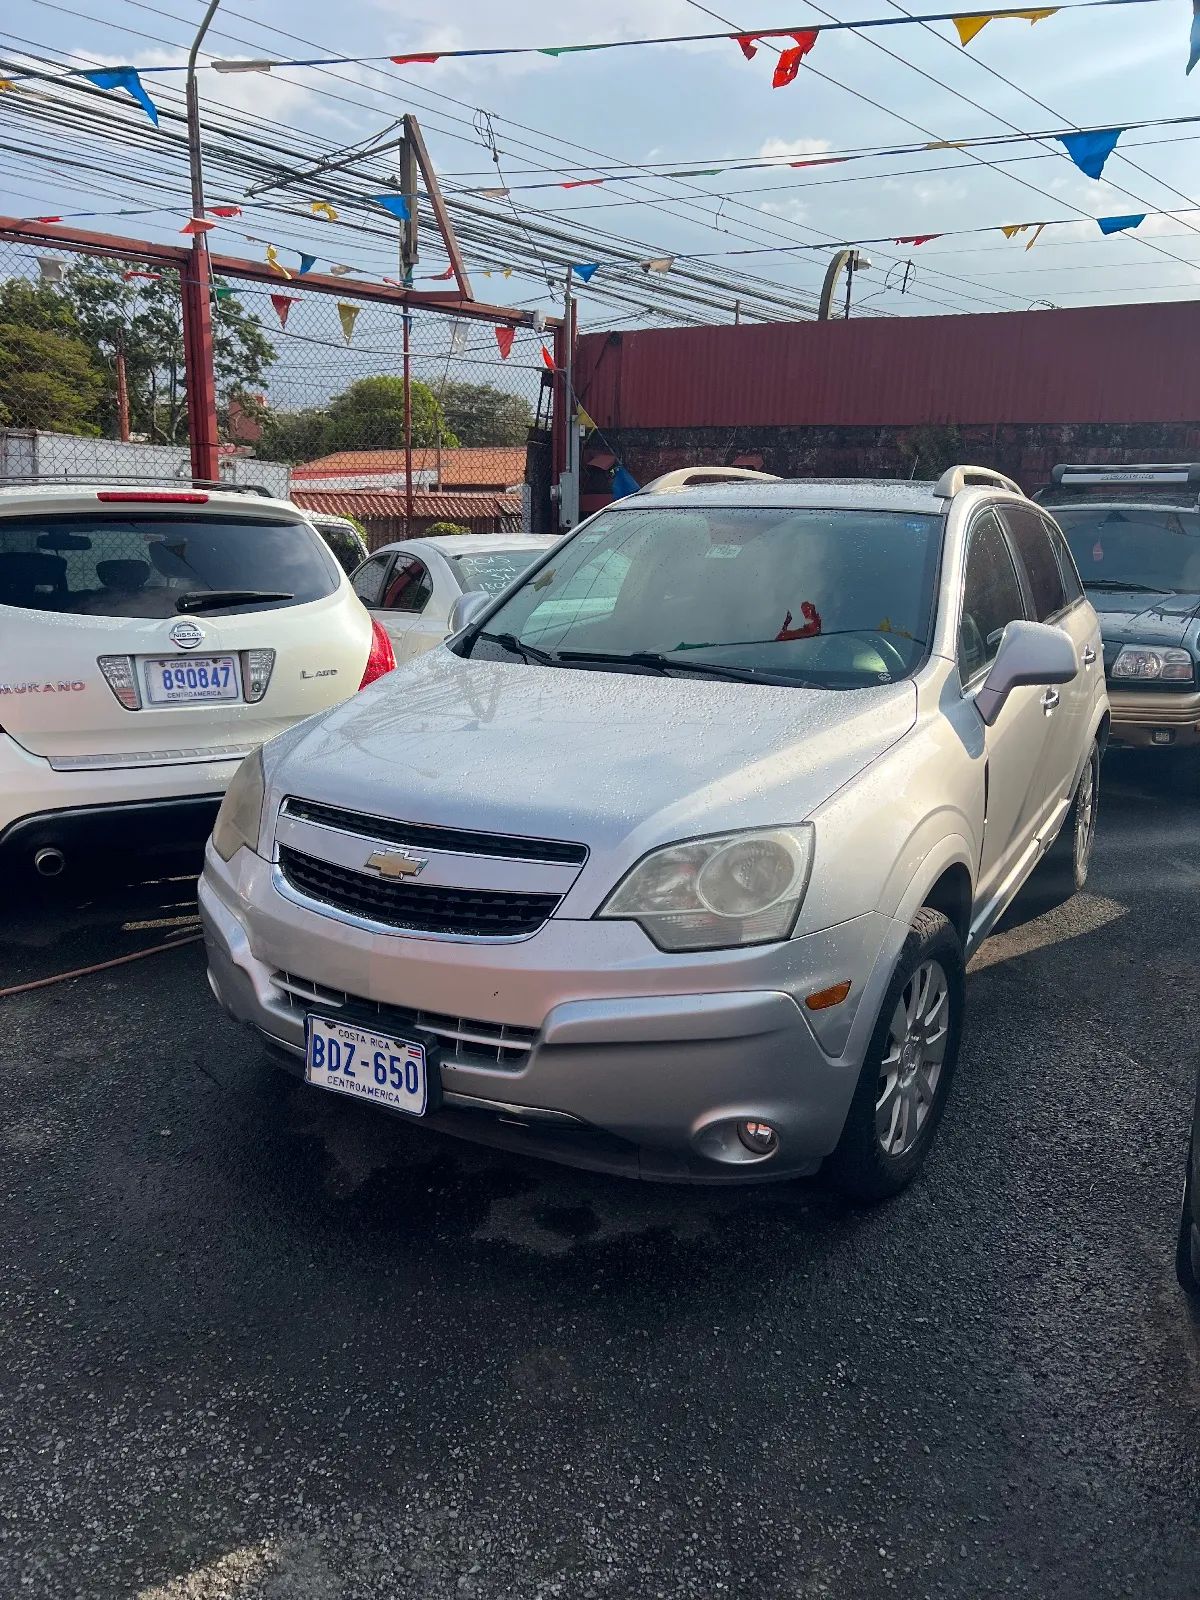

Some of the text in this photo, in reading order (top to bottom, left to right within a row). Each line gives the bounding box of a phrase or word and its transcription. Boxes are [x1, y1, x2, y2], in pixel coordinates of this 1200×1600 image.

[162, 667, 230, 690] 890847
[167, 690, 222, 699] CENTROAMERICA
[338, 1029, 391, 1051] COSTA RICA
[311, 1033, 419, 1094] BDZ-650
[326, 1075, 400, 1104] CENTROAMERICA
